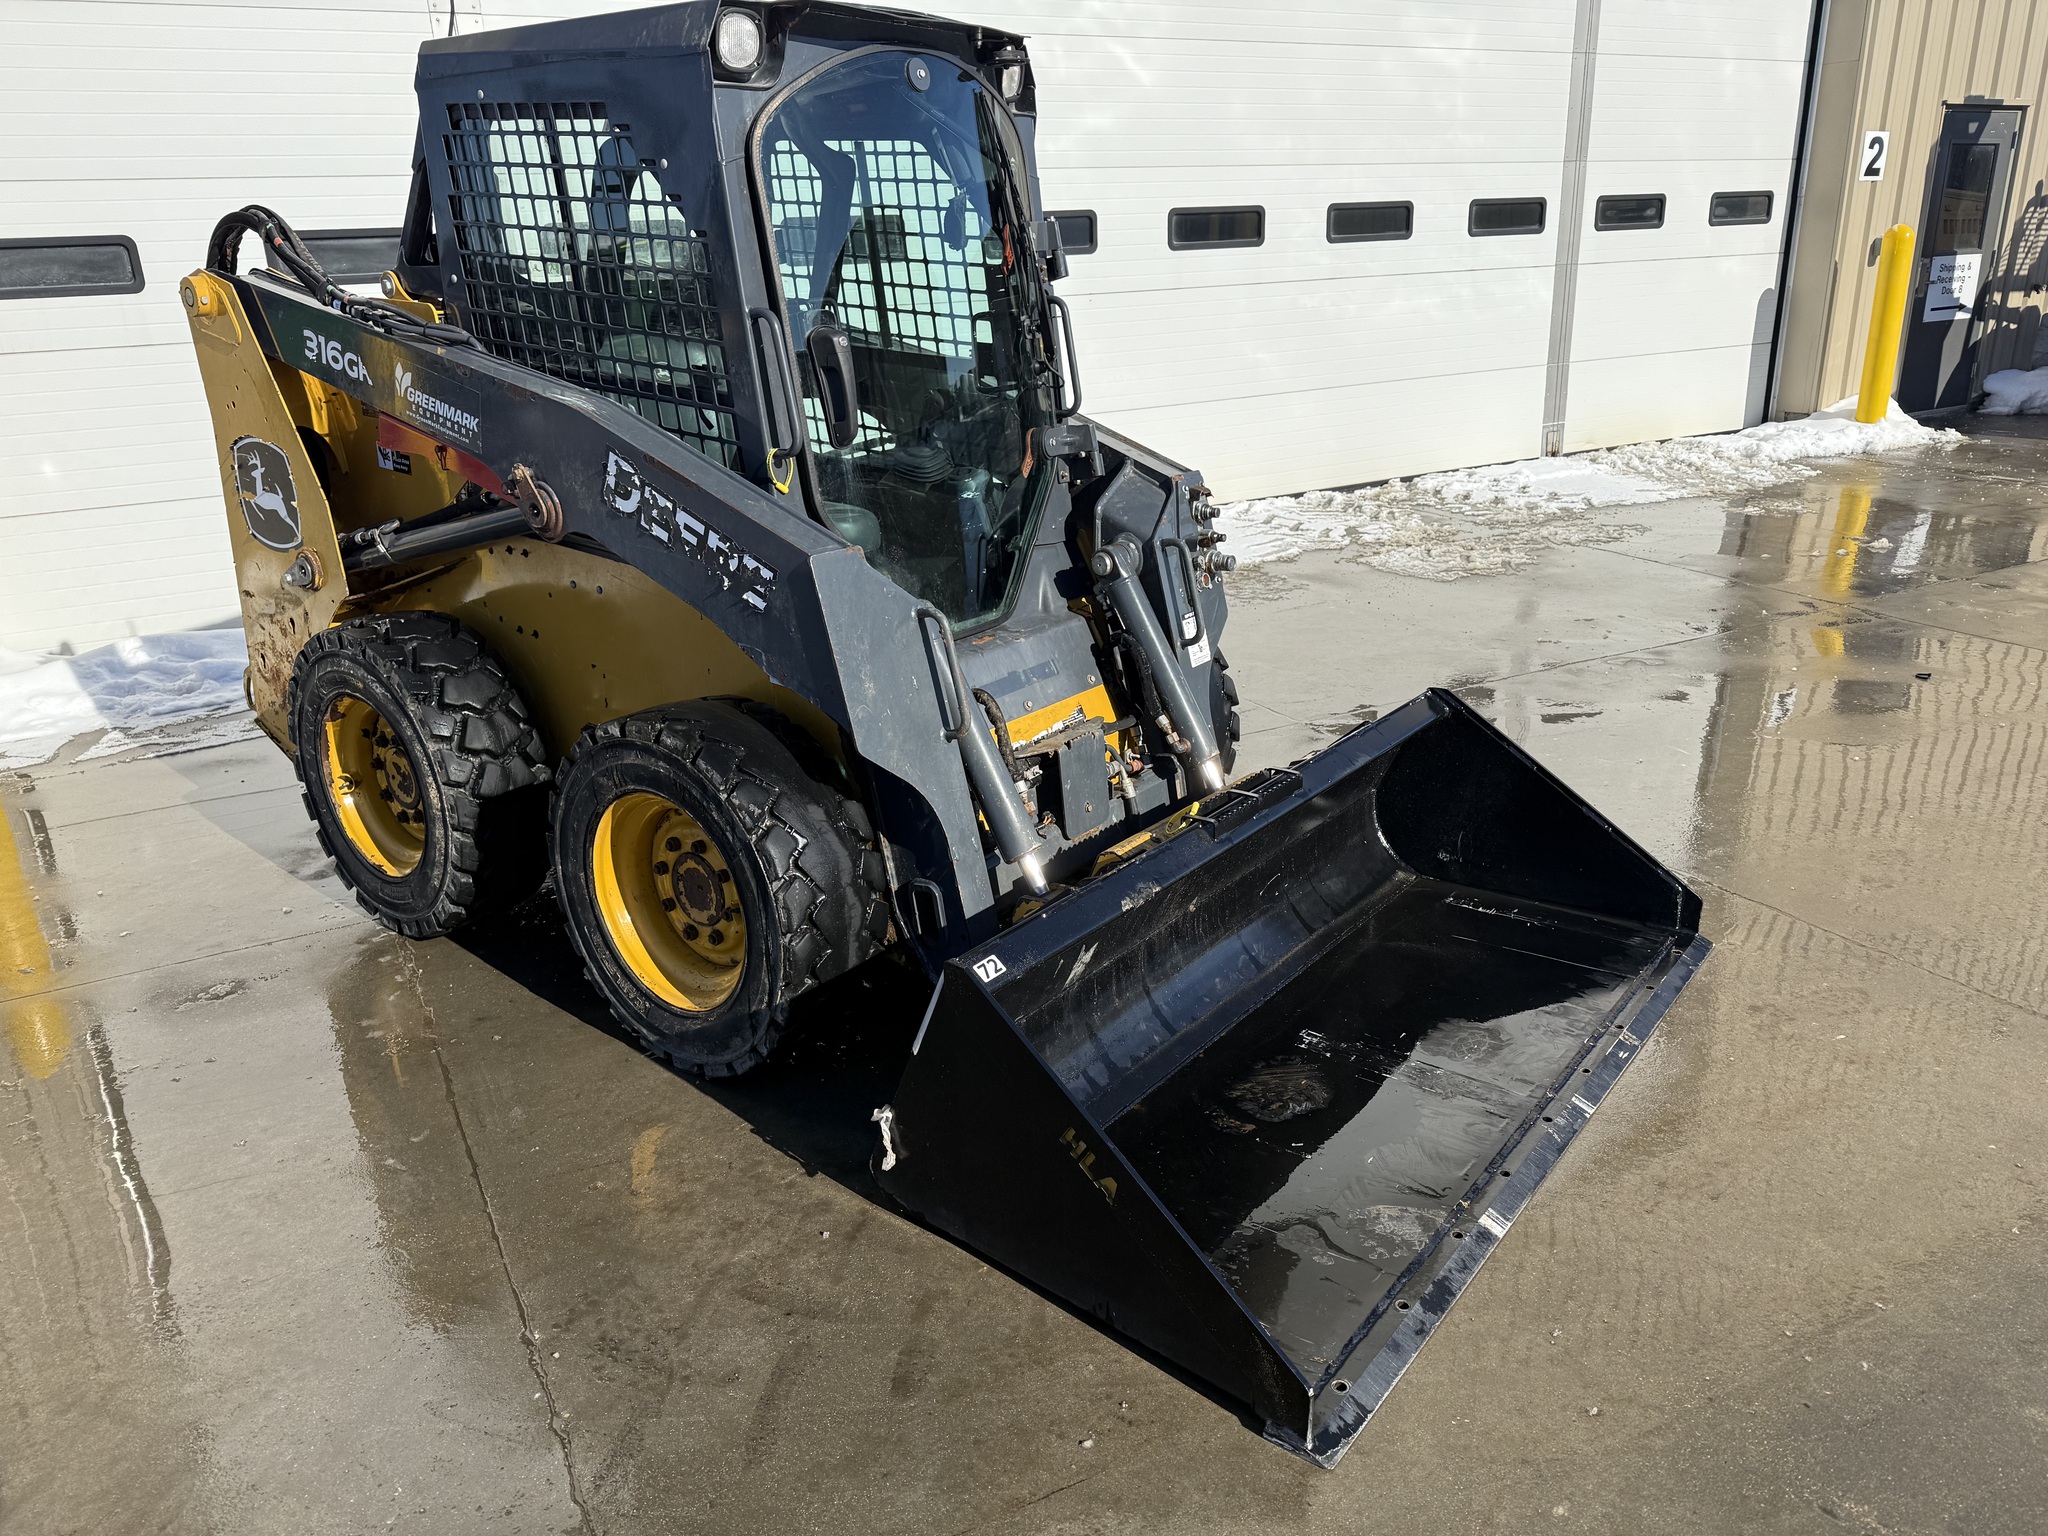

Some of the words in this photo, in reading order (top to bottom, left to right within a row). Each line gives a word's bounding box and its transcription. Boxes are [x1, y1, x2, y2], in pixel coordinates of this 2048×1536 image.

[1863, 136, 1884, 176] 2
[1939, 262, 1966, 273] Shipping
[1967, 262, 1972, 270] &
[1937, 274, 1966, 284] Receiving
[1941, 286, 1957, 295] Door
[407, 387, 479, 432] GREENMARK
[976, 958, 1003, 980] 72
[1059, 1126, 1118, 1206] HLA
